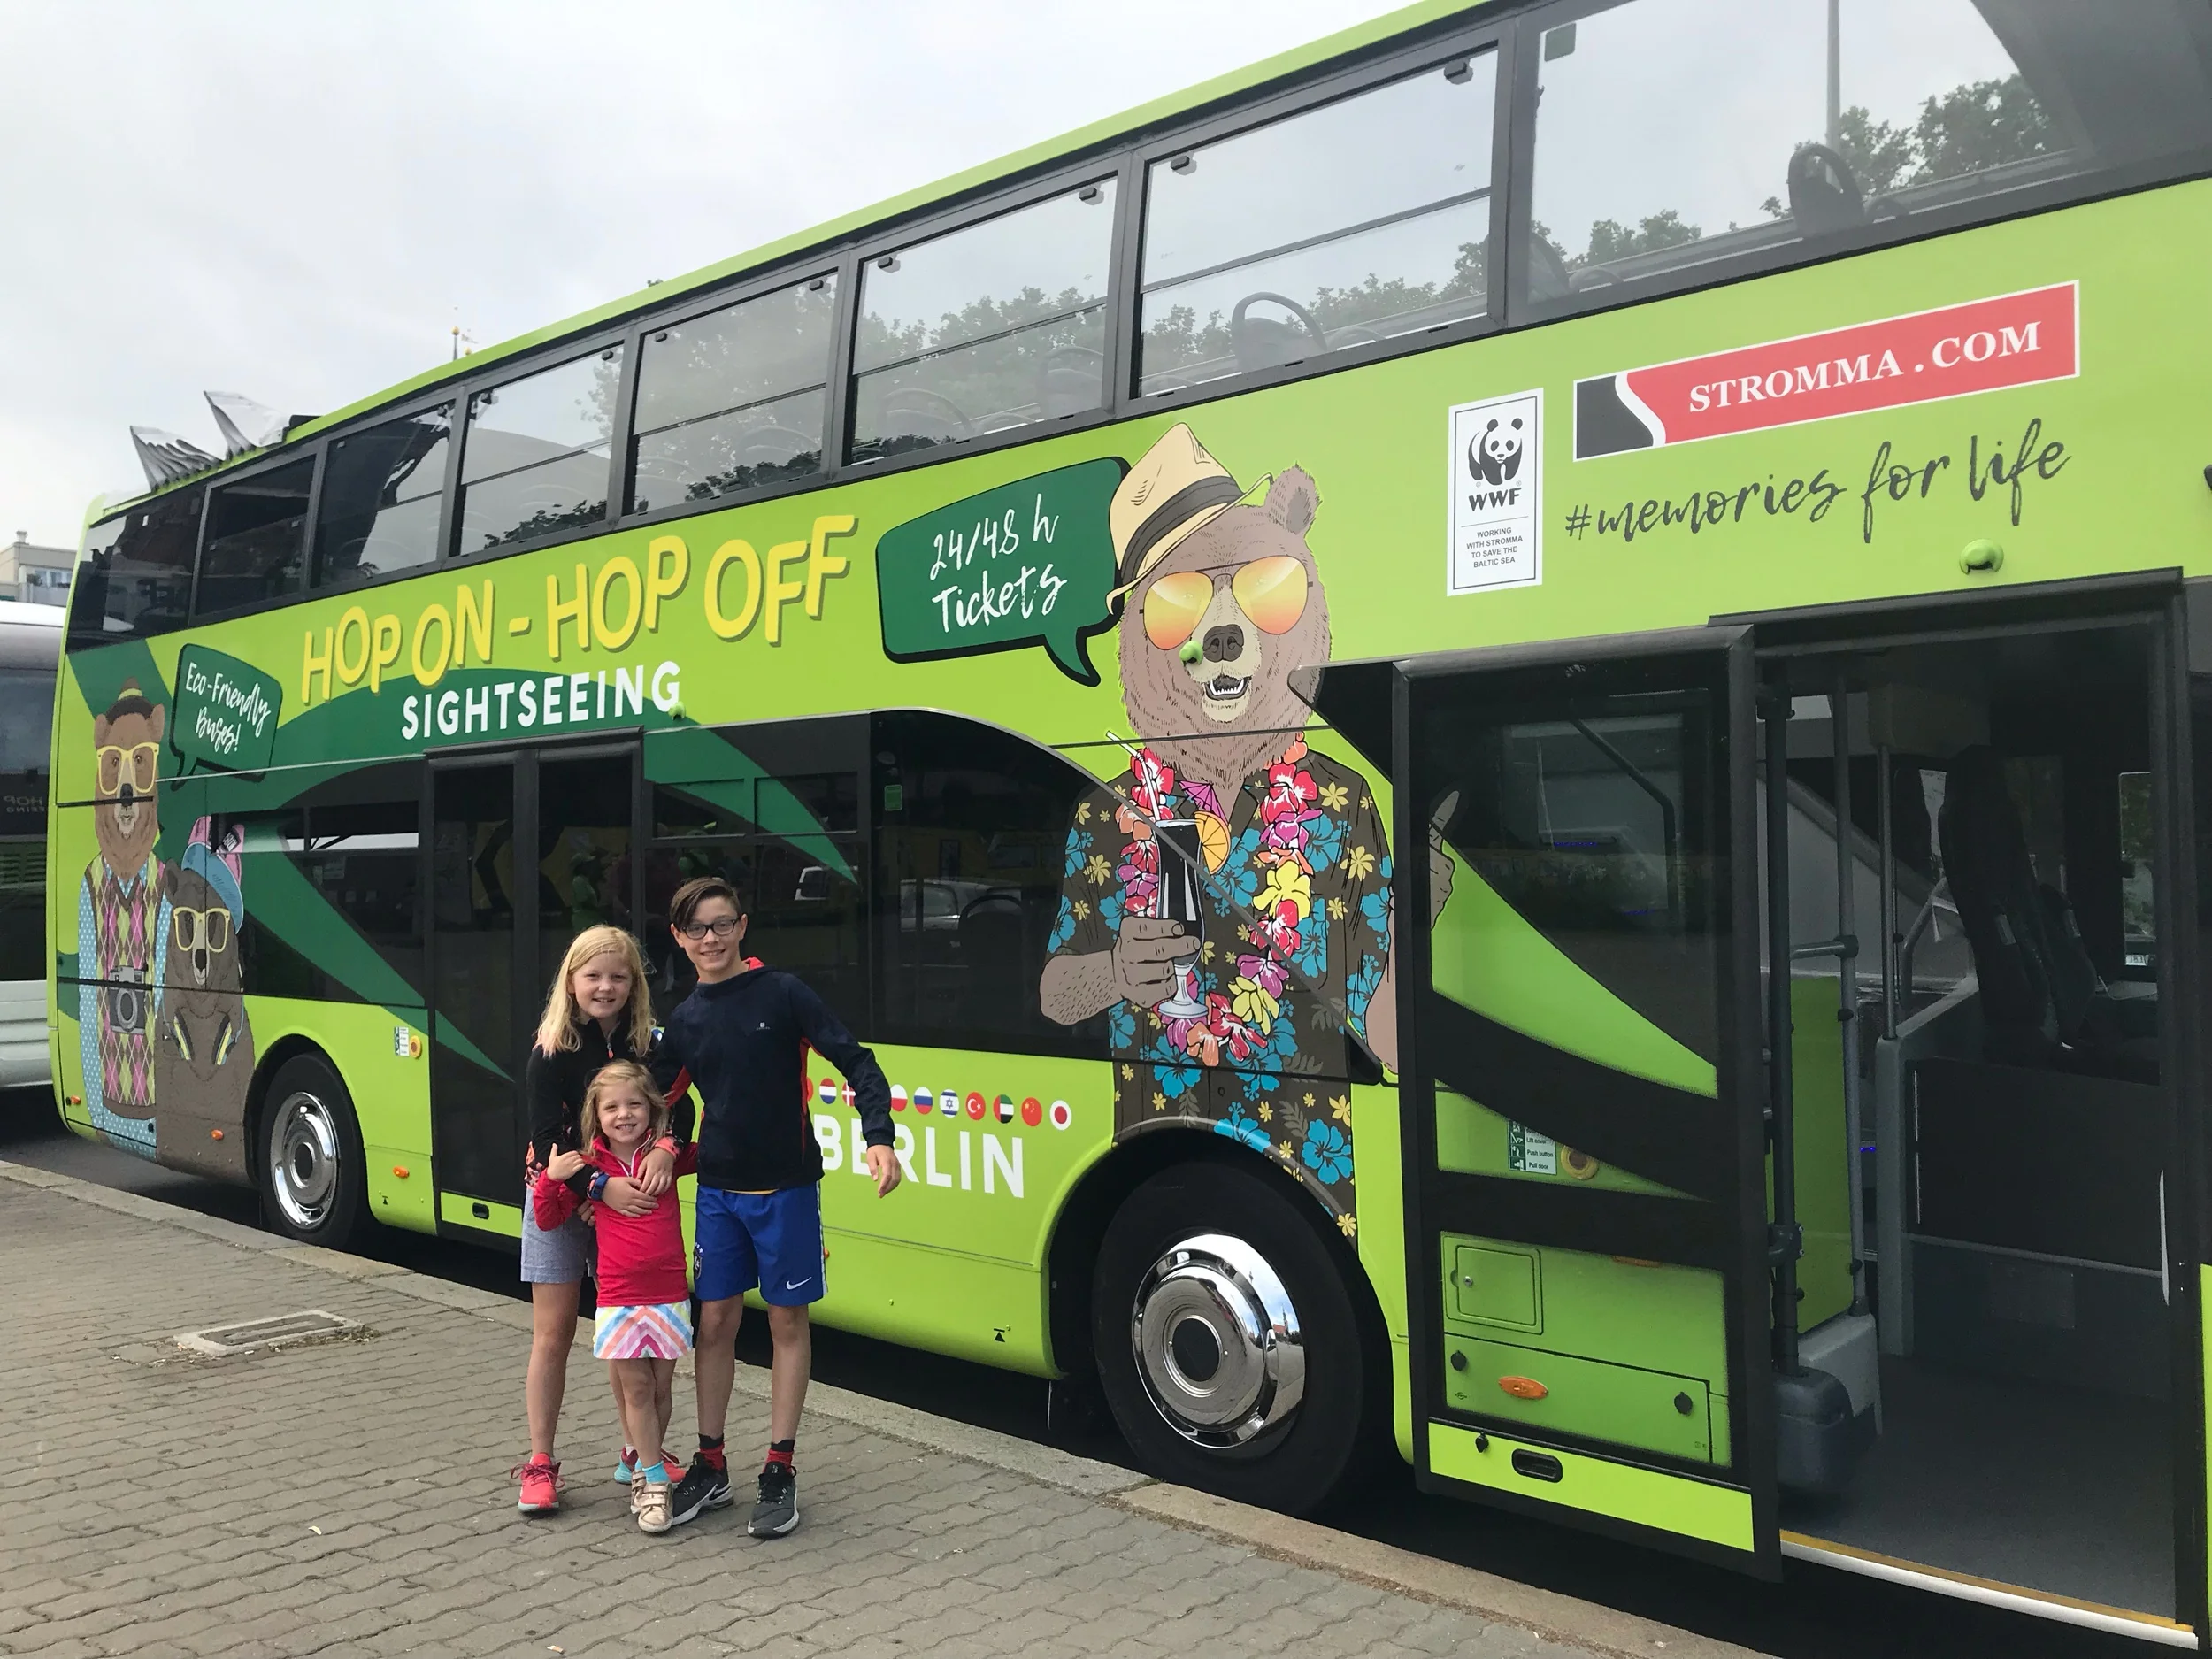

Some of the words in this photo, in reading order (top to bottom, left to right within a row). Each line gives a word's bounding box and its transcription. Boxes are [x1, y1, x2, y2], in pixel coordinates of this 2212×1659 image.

[1469, 488, 1522, 511] WWF
[1565, 469, 1847, 541] #memories
[1861, 441, 1950, 543] for
[1969, 418, 2072, 526] life
[930, 509, 1019, 580] 24/48
[1033, 493, 1059, 543] h
[1466, 541, 1485, 549] WITH
[1486, 535, 1523, 547] STROMMA
[1473, 558, 1499, 568] BALTIC
[1477, 527, 1512, 538] WORKING
[1482, 548, 1502, 557] SAVE
[302, 606, 401, 703] HOP
[411, 579, 494, 686] ON
[546, 535, 688, 659] HOP
[703, 515, 855, 643] OFF
[932, 564, 1068, 633] Tickets
[185, 662, 272, 738] Eco-Friendly
[402, 660, 680, 740] SIGHTSEEING
[813, 1113, 1024, 1198] BERLIN
